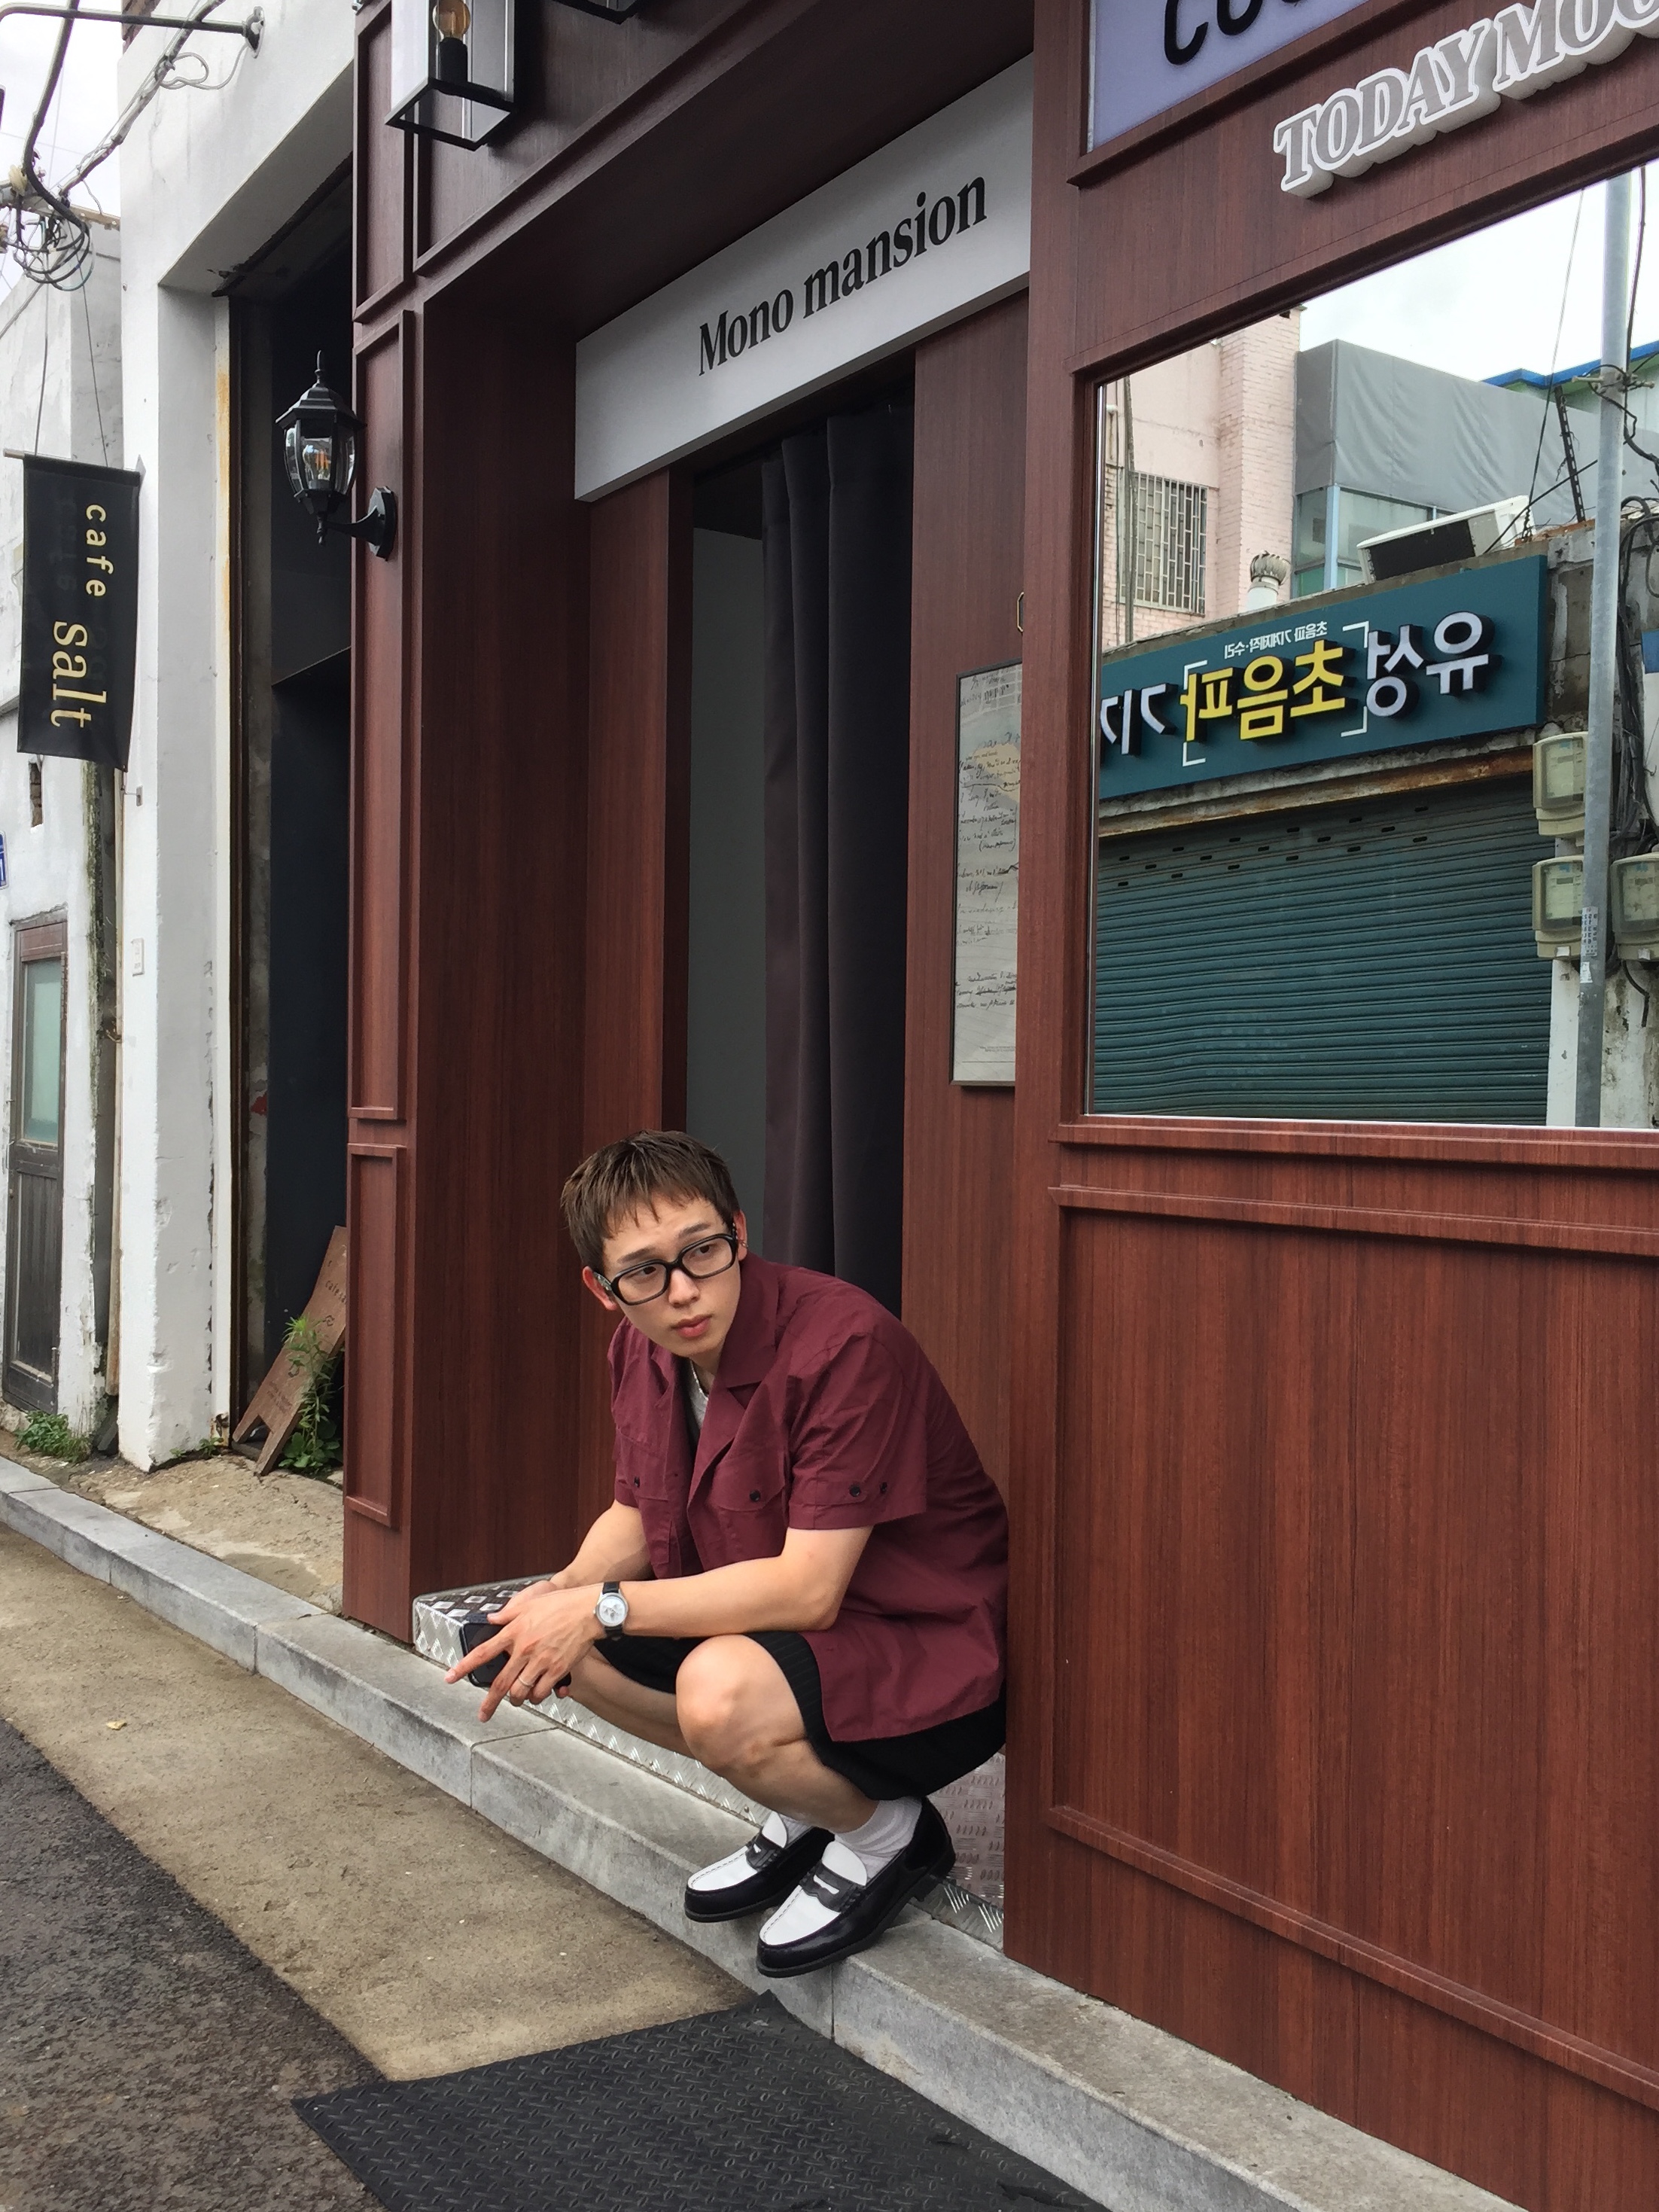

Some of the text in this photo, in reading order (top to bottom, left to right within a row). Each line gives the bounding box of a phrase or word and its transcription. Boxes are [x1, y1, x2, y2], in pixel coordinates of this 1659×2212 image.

[699, 176, 987, 376] Mono mansion
[86, 504, 114, 597] cafe
[50, 620, 107, 729] salt
